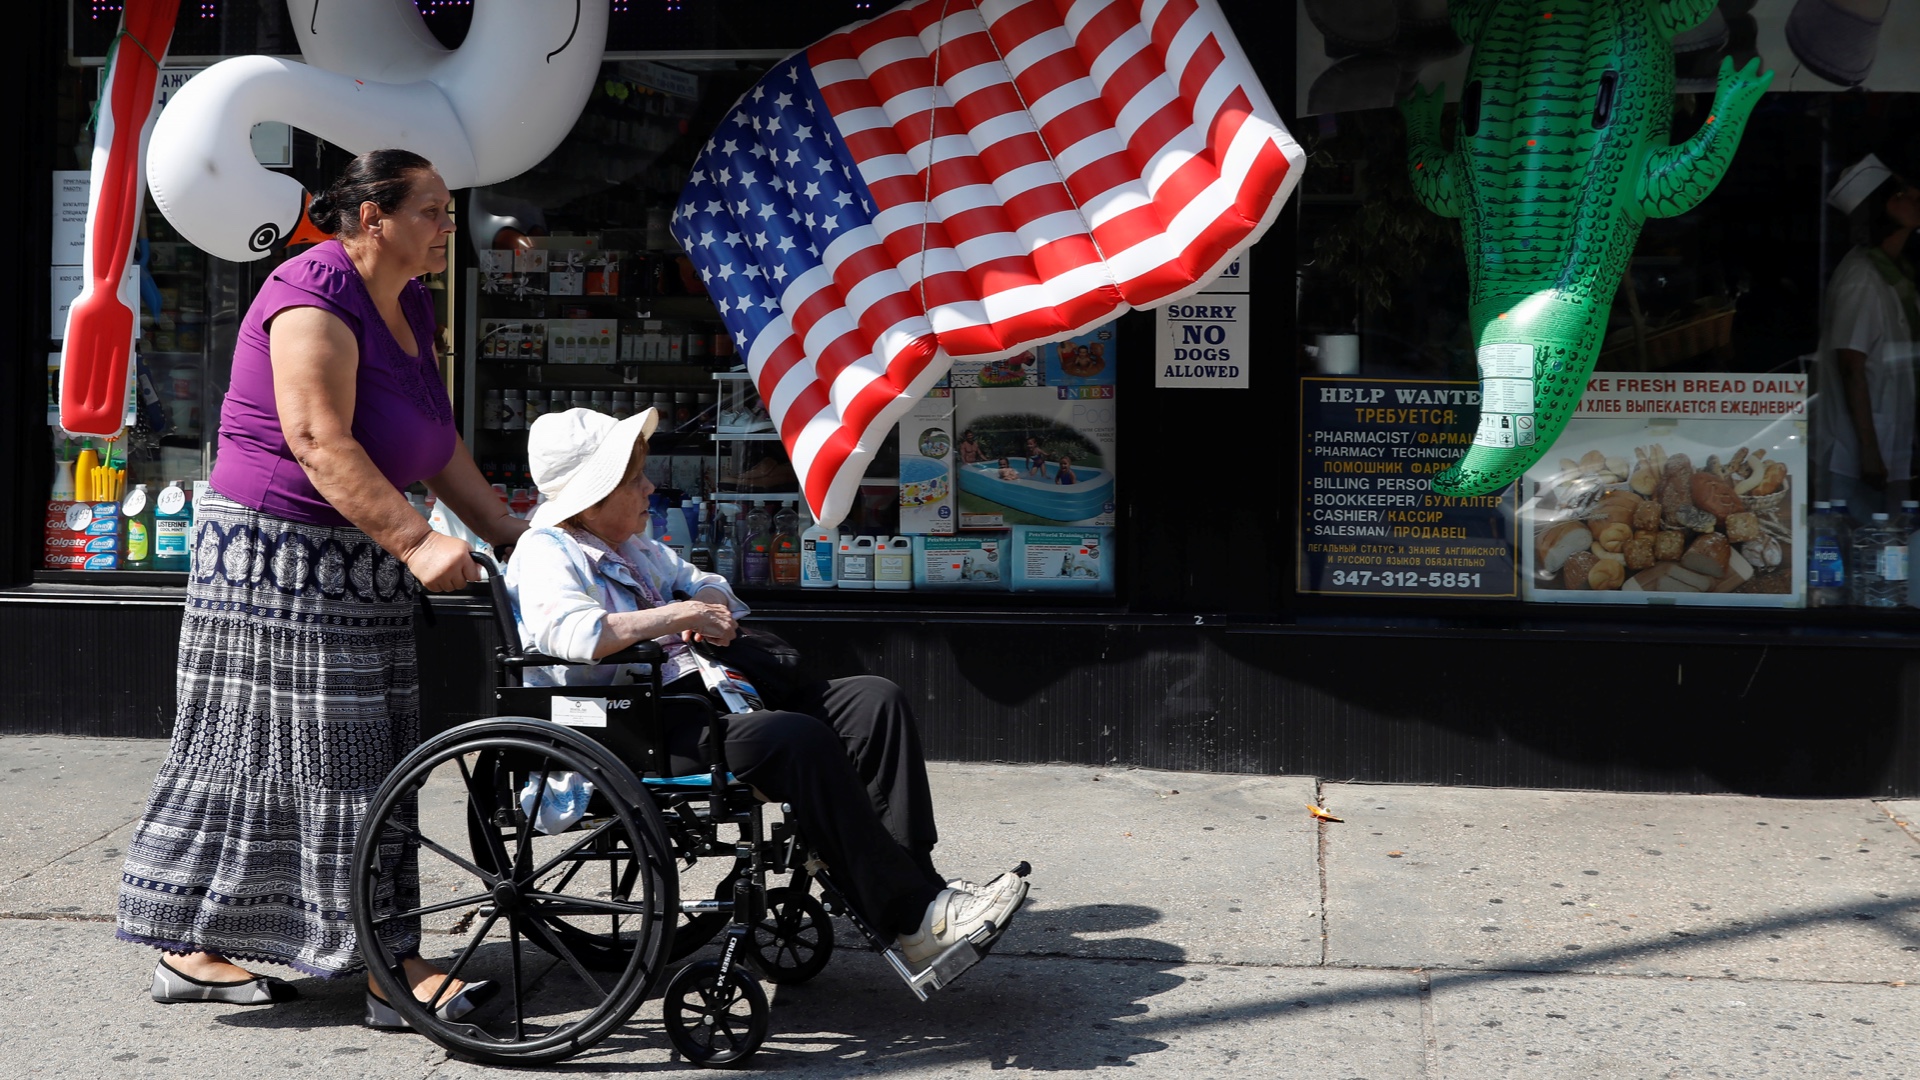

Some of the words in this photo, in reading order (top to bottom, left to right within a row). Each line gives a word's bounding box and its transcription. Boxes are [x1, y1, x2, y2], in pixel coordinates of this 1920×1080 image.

[1168, 305, 1237, 319] SORRY
[1182, 325, 1226, 345] NO
[1174, 348, 1230, 361] DOGS
[1164, 365, 1239, 378] ALLOWED
[1586, 378, 1610, 392] KE
[1617, 379, 1676, 392] FRESH
[1683, 379, 1746, 393] BREAD
[1753, 380, 1805, 393] DAILY
[1059, 387, 1111, 398] INTEX
[1320, 387, 1385, 403] HELP
[1395, 389, 1481, 405] WANTE
[1072, 404, 1114, 424] Pool
[1586, 399, 1621, 412] ХЛЕБ
[1626, 399, 1716, 413] ВЫПЕКАЕТСЯ
[1721, 400, 1804, 416] ЕЖЕДНЕВНО
[1355, 408, 1458, 425] ТРЕБУЕТСЯ:
[1314, 446, 1385, 457] PHARMACY
[1324, 461, 1403, 473] ПОМОШНИК
[1313, 477, 1370, 490] BILLING
[46, 520, 69, 531] Colg
[46, 537, 86, 547] Colgate
[1361, 545, 1395, 554] СТАТУС
[1398, 546, 1404, 554] И
[1408, 546, 1440, 555] ЗНАНИЕ
[1445, 545, 1506, 556] АНГЛИЙСКОГО
[1814, 551, 1838, 562] Hydrate
[45, 554, 85, 564] Colgate
[1327, 555, 1333, 563] И
[1337, 556, 1381, 564] РУССКОГО
[1386, 557, 1420, 565] ЯЗЫКОВ
[1425, 557, 1485, 567] ОБЯЗАТЕЛЬНО
[1332, 570, 1481, 588] 347-312-5851
[607, 699, 631, 710] ive
[720, 937, 738, 973] CRUISER
[716, 973, 726, 987] X4
